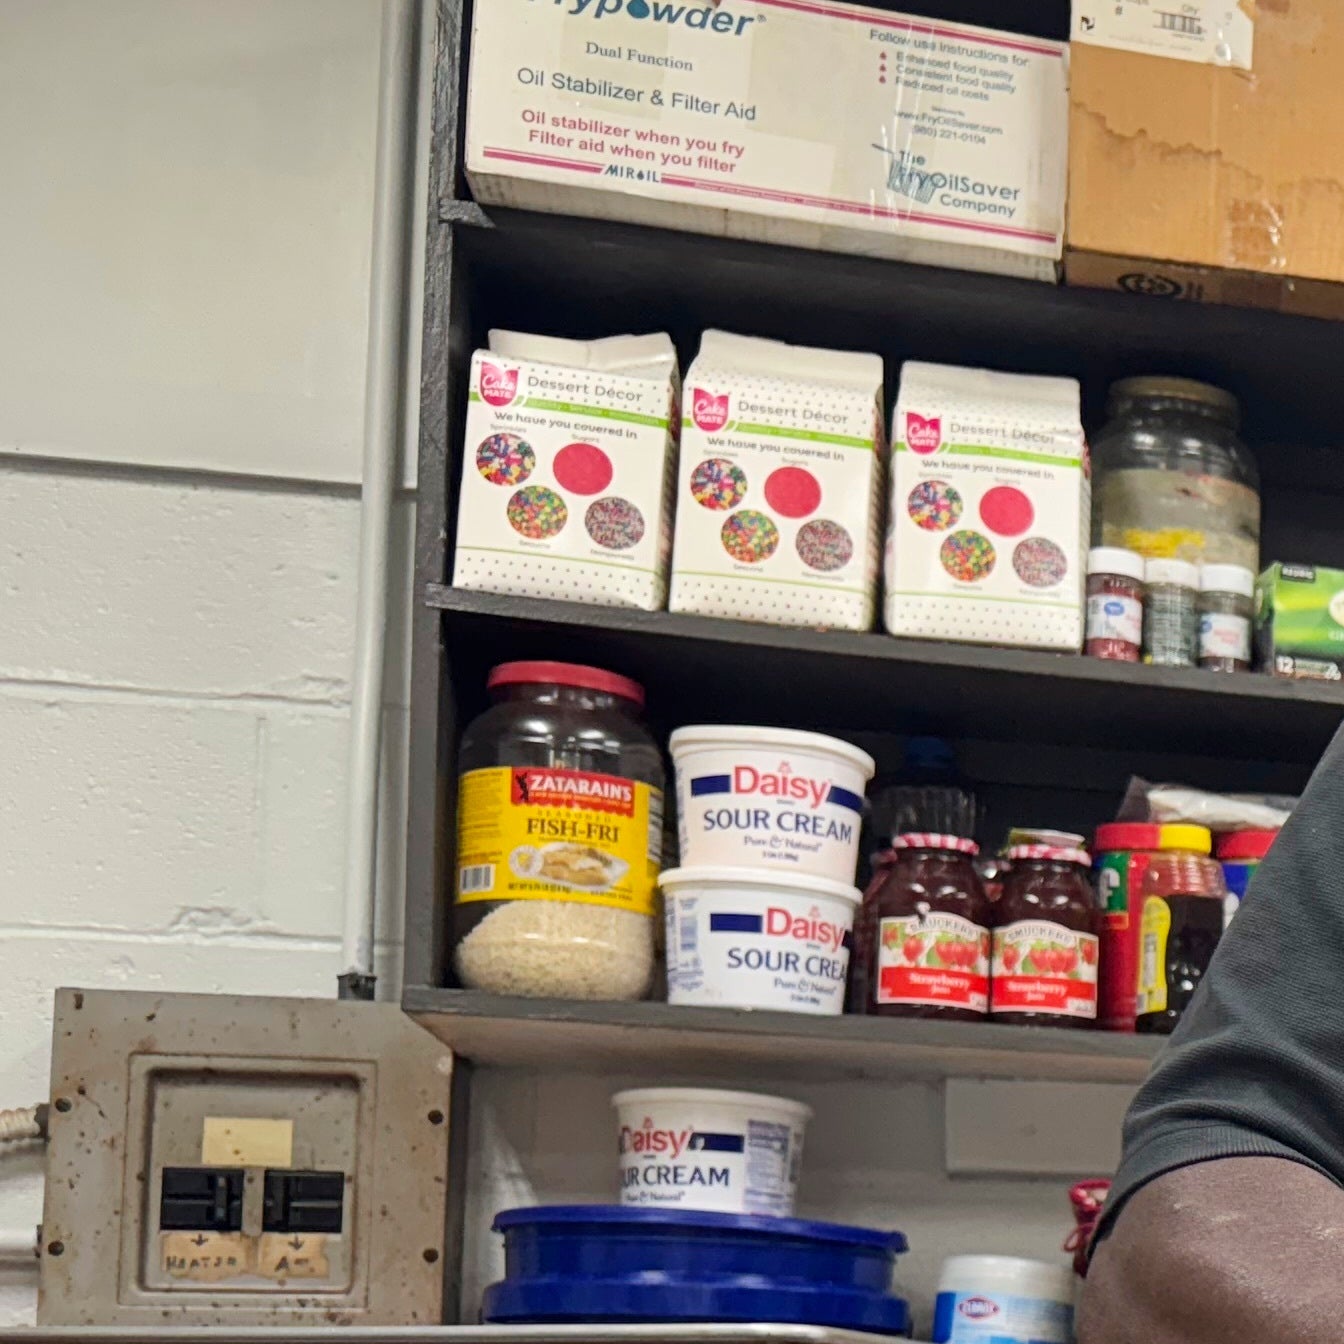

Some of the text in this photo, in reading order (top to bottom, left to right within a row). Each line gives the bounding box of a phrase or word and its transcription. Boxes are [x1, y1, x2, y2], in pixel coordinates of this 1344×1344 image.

[527, 0, 755, 36] ypowder
[586, 41, 693, 72] Dual Function
[517, 67, 757, 121] Oil Stabilizer & Filter Aid
[521, 108, 745, 159] Oil stabilizer when you fry
[529, 129, 737, 173] Filter aid when you filter
[940, 193, 1017, 219] Company
[528, 375, 643, 402] Dessert Décor
[494, 411, 513, 423] We
[516, 411, 547, 427] have
[549, 419, 571, 431] you
[627, 428, 638, 440] in
[738, 400, 848, 425] Dessert Décor
[707, 436, 725, 447] We
[950, 422, 1006, 439] Dessert
[530, 774, 633, 803] ZATARAIN'S
[734, 764, 829, 809] Daisy
[527, 817, 620, 844] FISH-FRI
[703, 808, 852, 845] SOUR CREAM
[766, 907, 845, 953] Daisy
[727, 946, 800, 974] SOUR
[643, 1164, 730, 1187] CREAM
